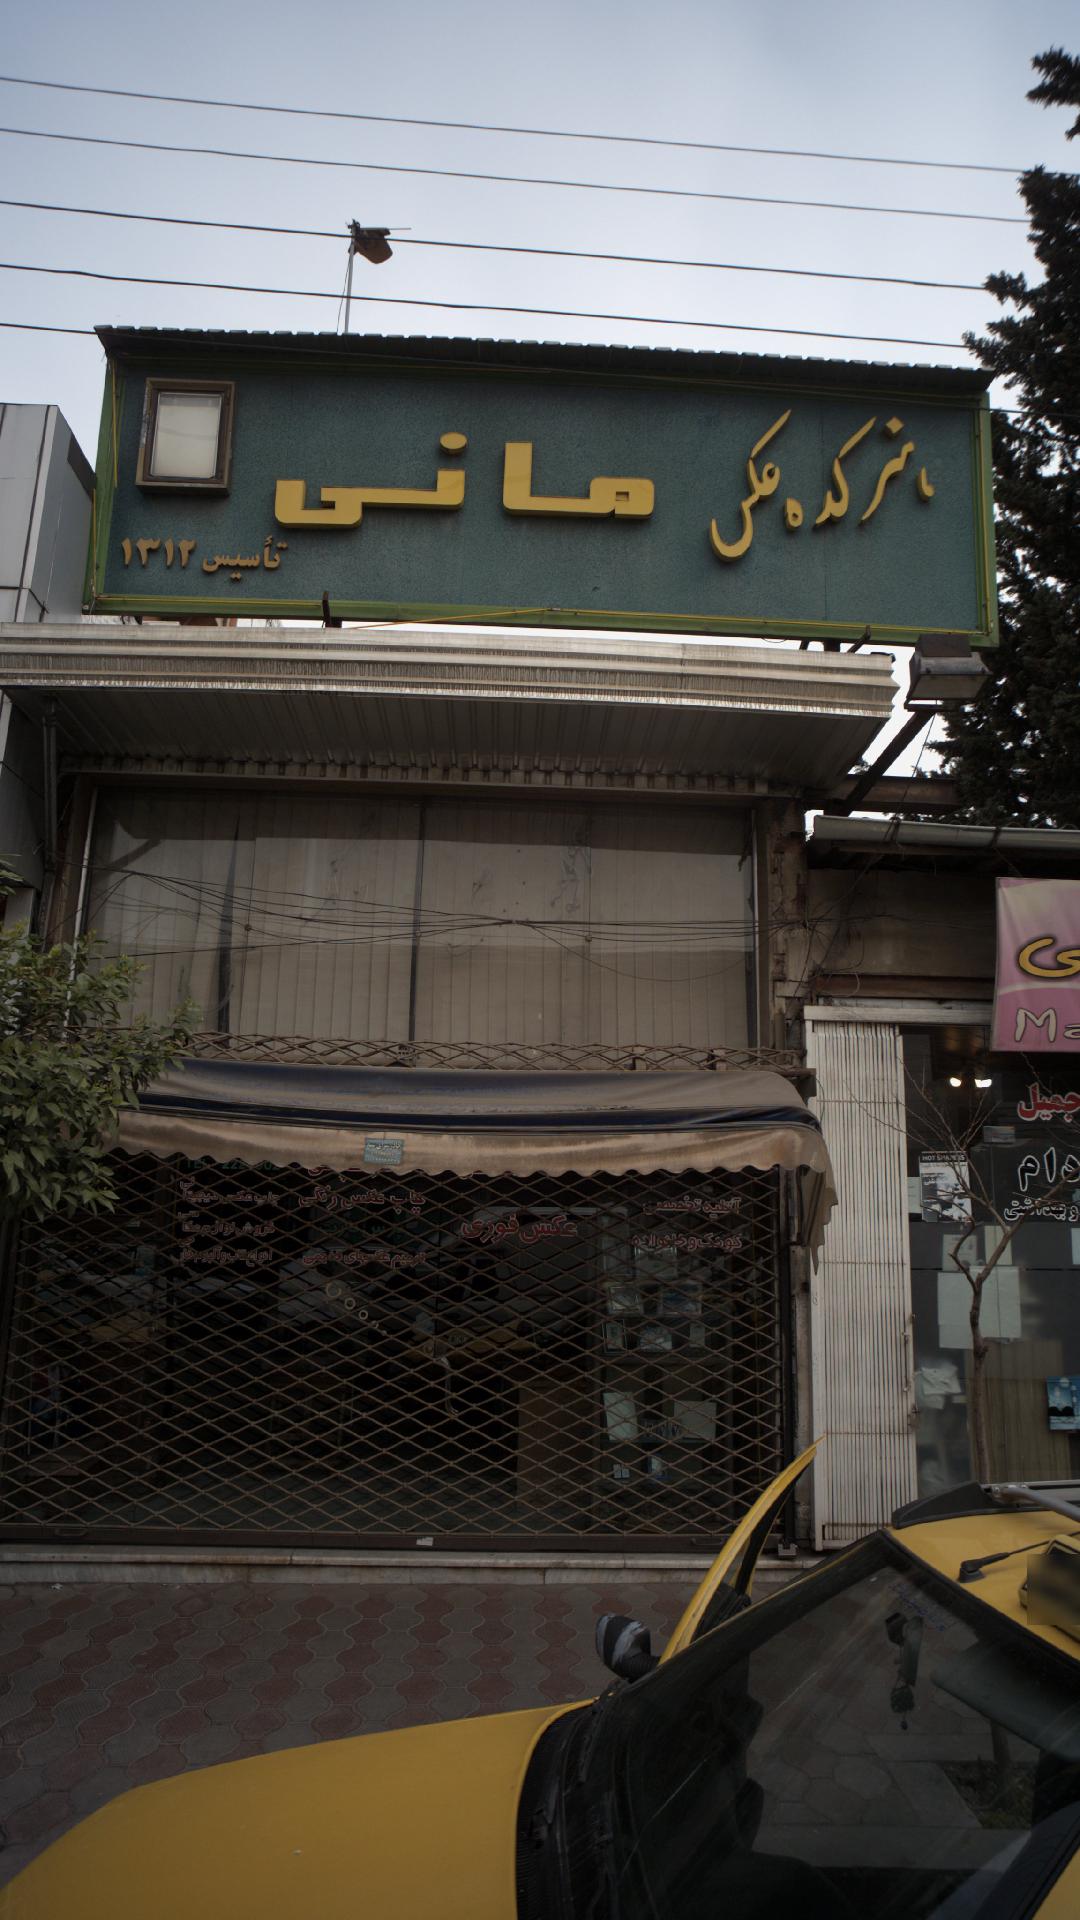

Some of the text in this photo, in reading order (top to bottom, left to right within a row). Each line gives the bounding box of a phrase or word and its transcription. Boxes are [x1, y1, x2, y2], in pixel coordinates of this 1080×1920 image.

[202, 534, 288, 582] تأسیس
[460, 1213, 519, 1244] فوری
[518, 1214, 578, 1245] عکس
